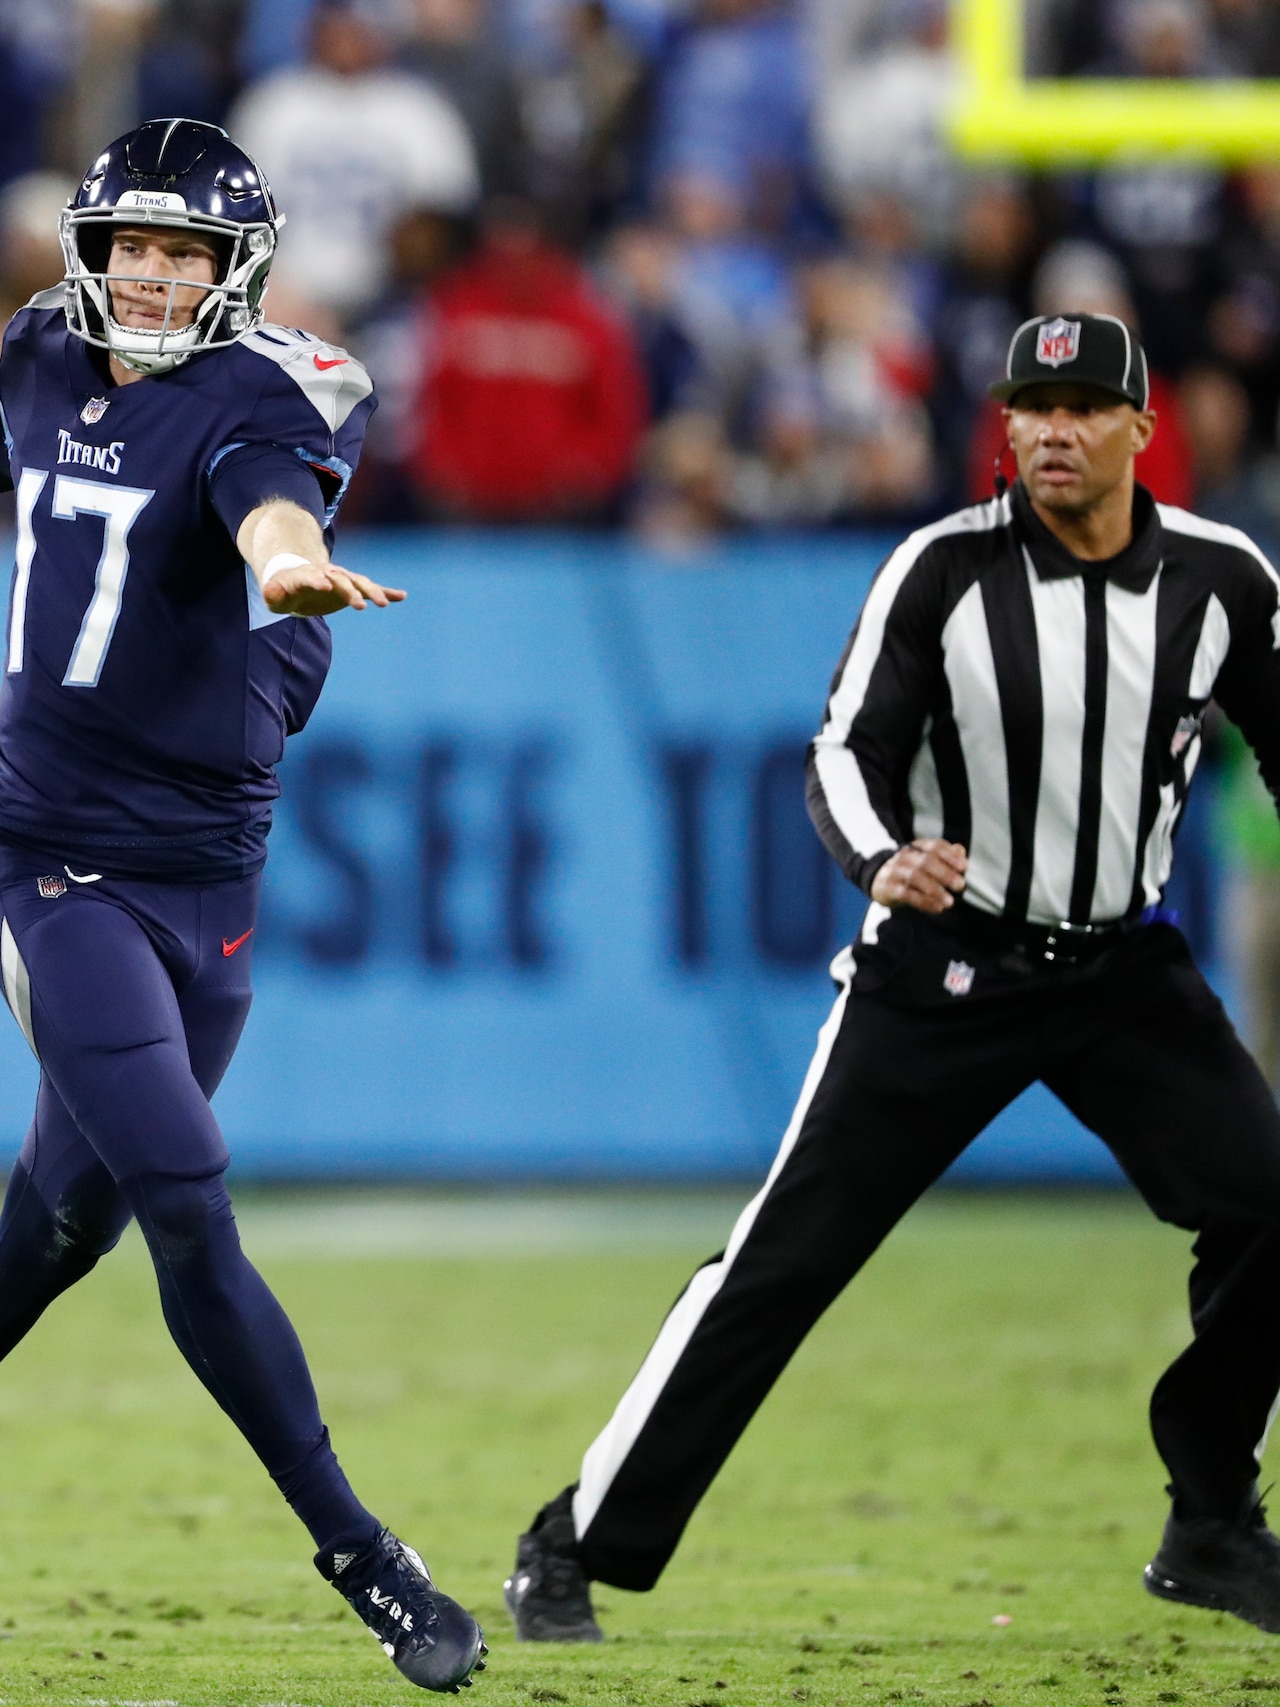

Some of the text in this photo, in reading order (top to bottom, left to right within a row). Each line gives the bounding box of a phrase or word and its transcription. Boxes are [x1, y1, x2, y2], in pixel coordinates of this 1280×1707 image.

[1042, 335, 1074, 359] NFL
[6, 466, 157, 688] 17
[335, 1552, 358, 1575] adidas
